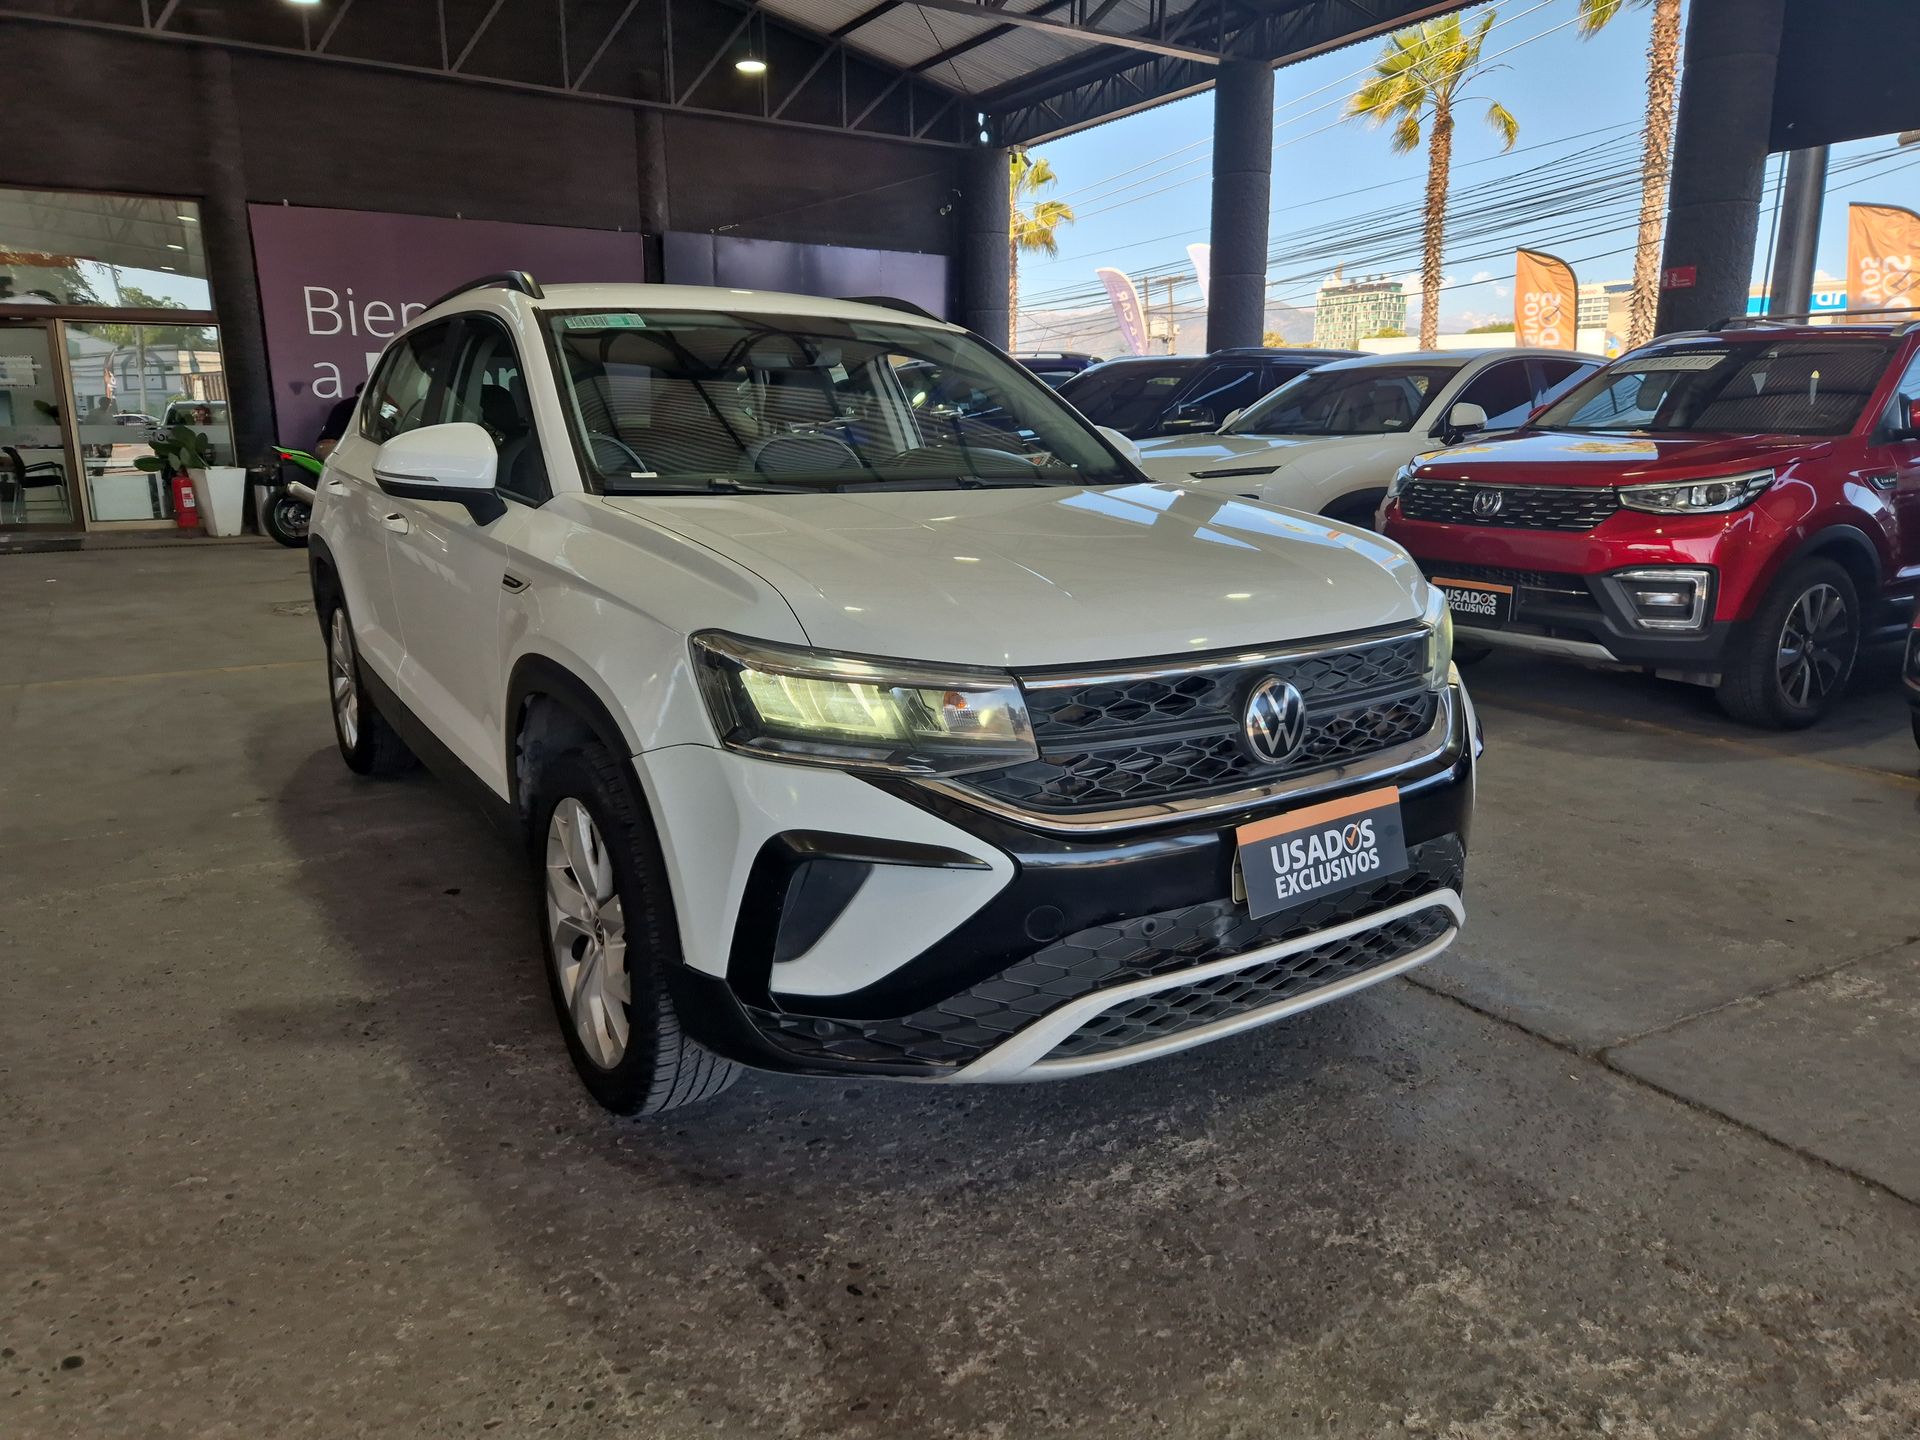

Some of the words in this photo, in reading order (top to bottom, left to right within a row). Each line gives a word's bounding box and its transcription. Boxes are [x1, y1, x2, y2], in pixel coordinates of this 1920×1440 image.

[312, 361, 343, 399] a
[1445, 589, 1497, 606] USADOS
[1449, 601, 1497, 616] XCLUSIVOS
[1270, 818, 1376, 875] USADOS
[1274, 847, 1380, 900] EXCLUSIVOS
